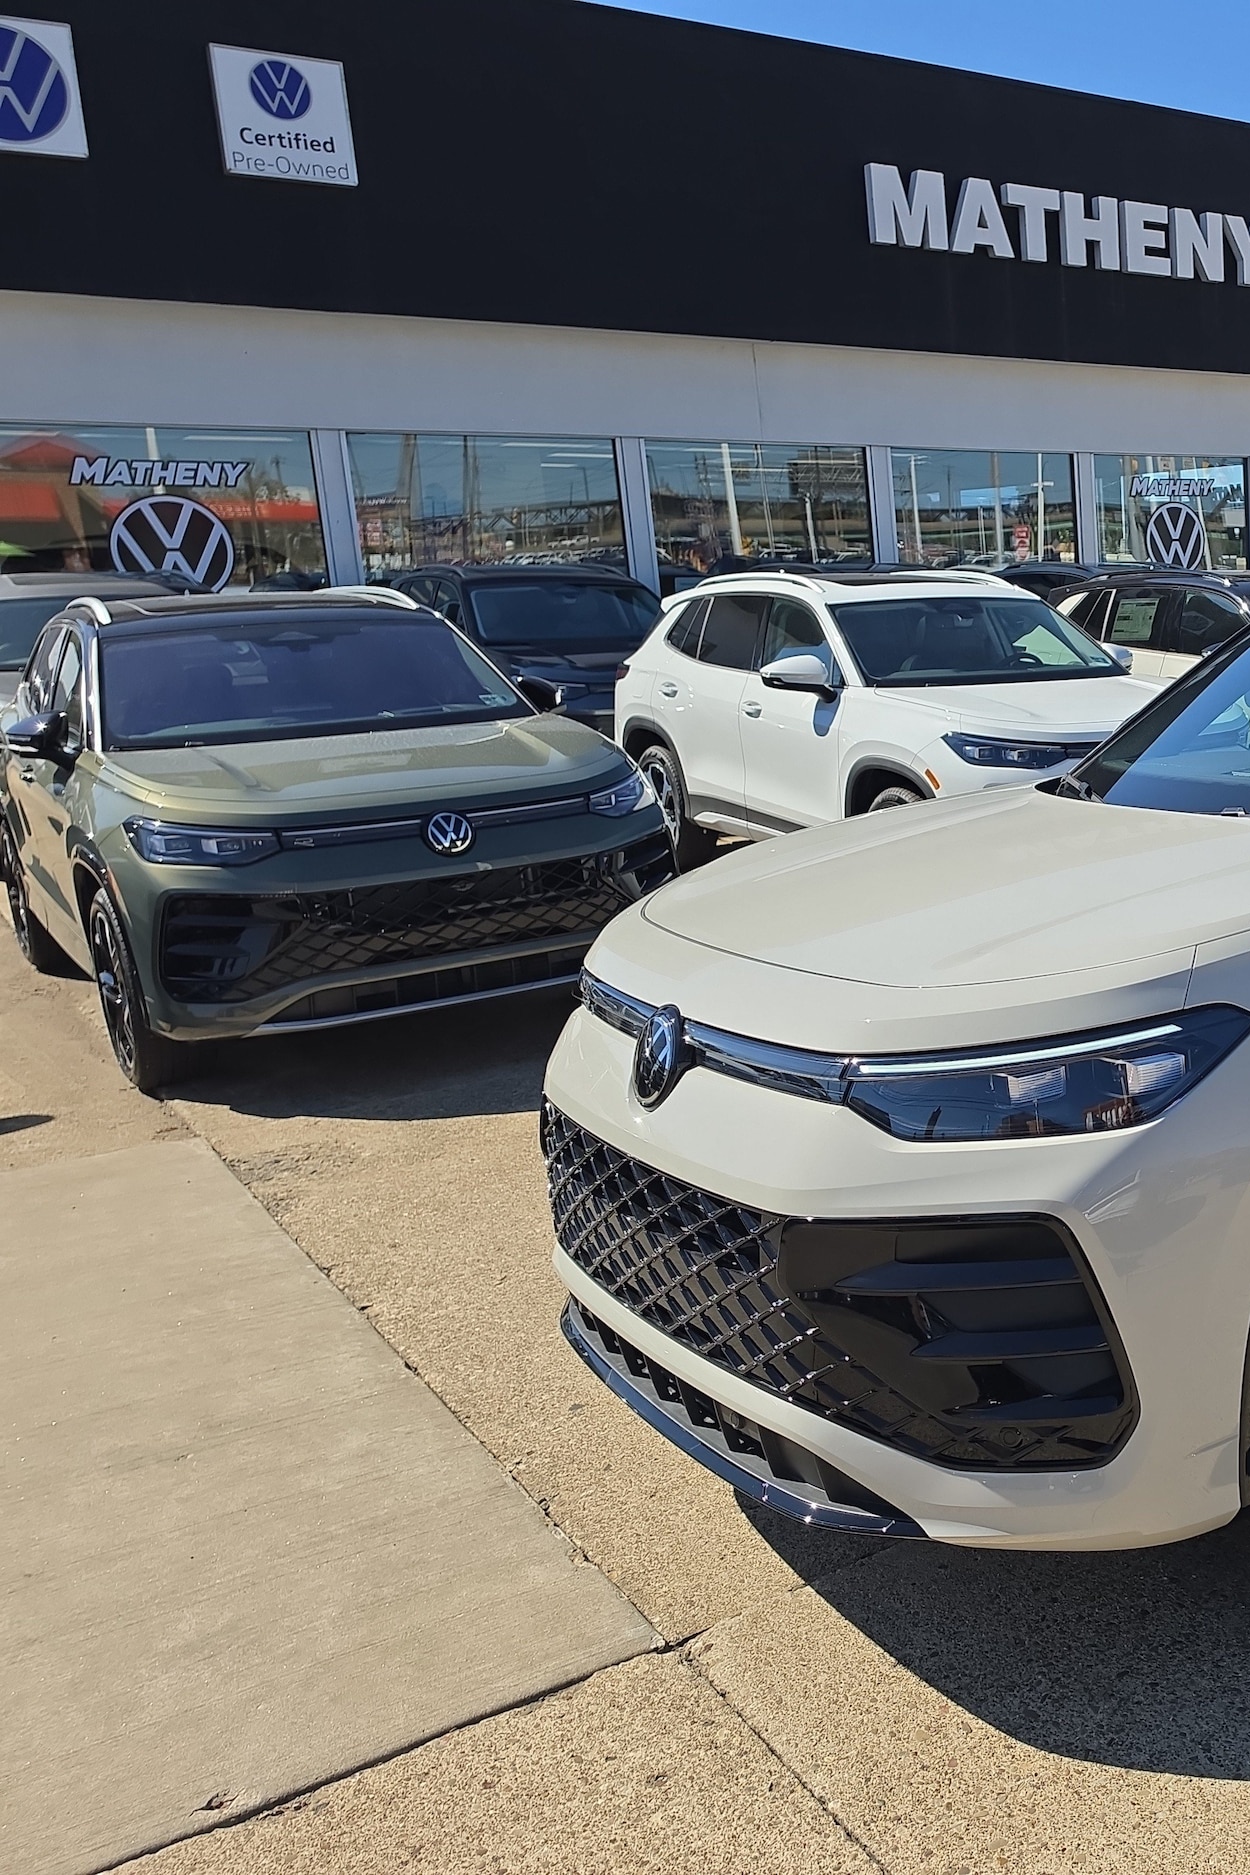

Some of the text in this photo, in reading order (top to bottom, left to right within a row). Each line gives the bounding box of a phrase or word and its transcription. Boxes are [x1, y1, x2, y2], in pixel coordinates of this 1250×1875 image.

[239, 127, 336, 154] Certified
[231, 151, 351, 180] Pre-Owned
[69, 456, 250, 487] MATHENY
[1130, 476, 1214, 497] MATHENY
